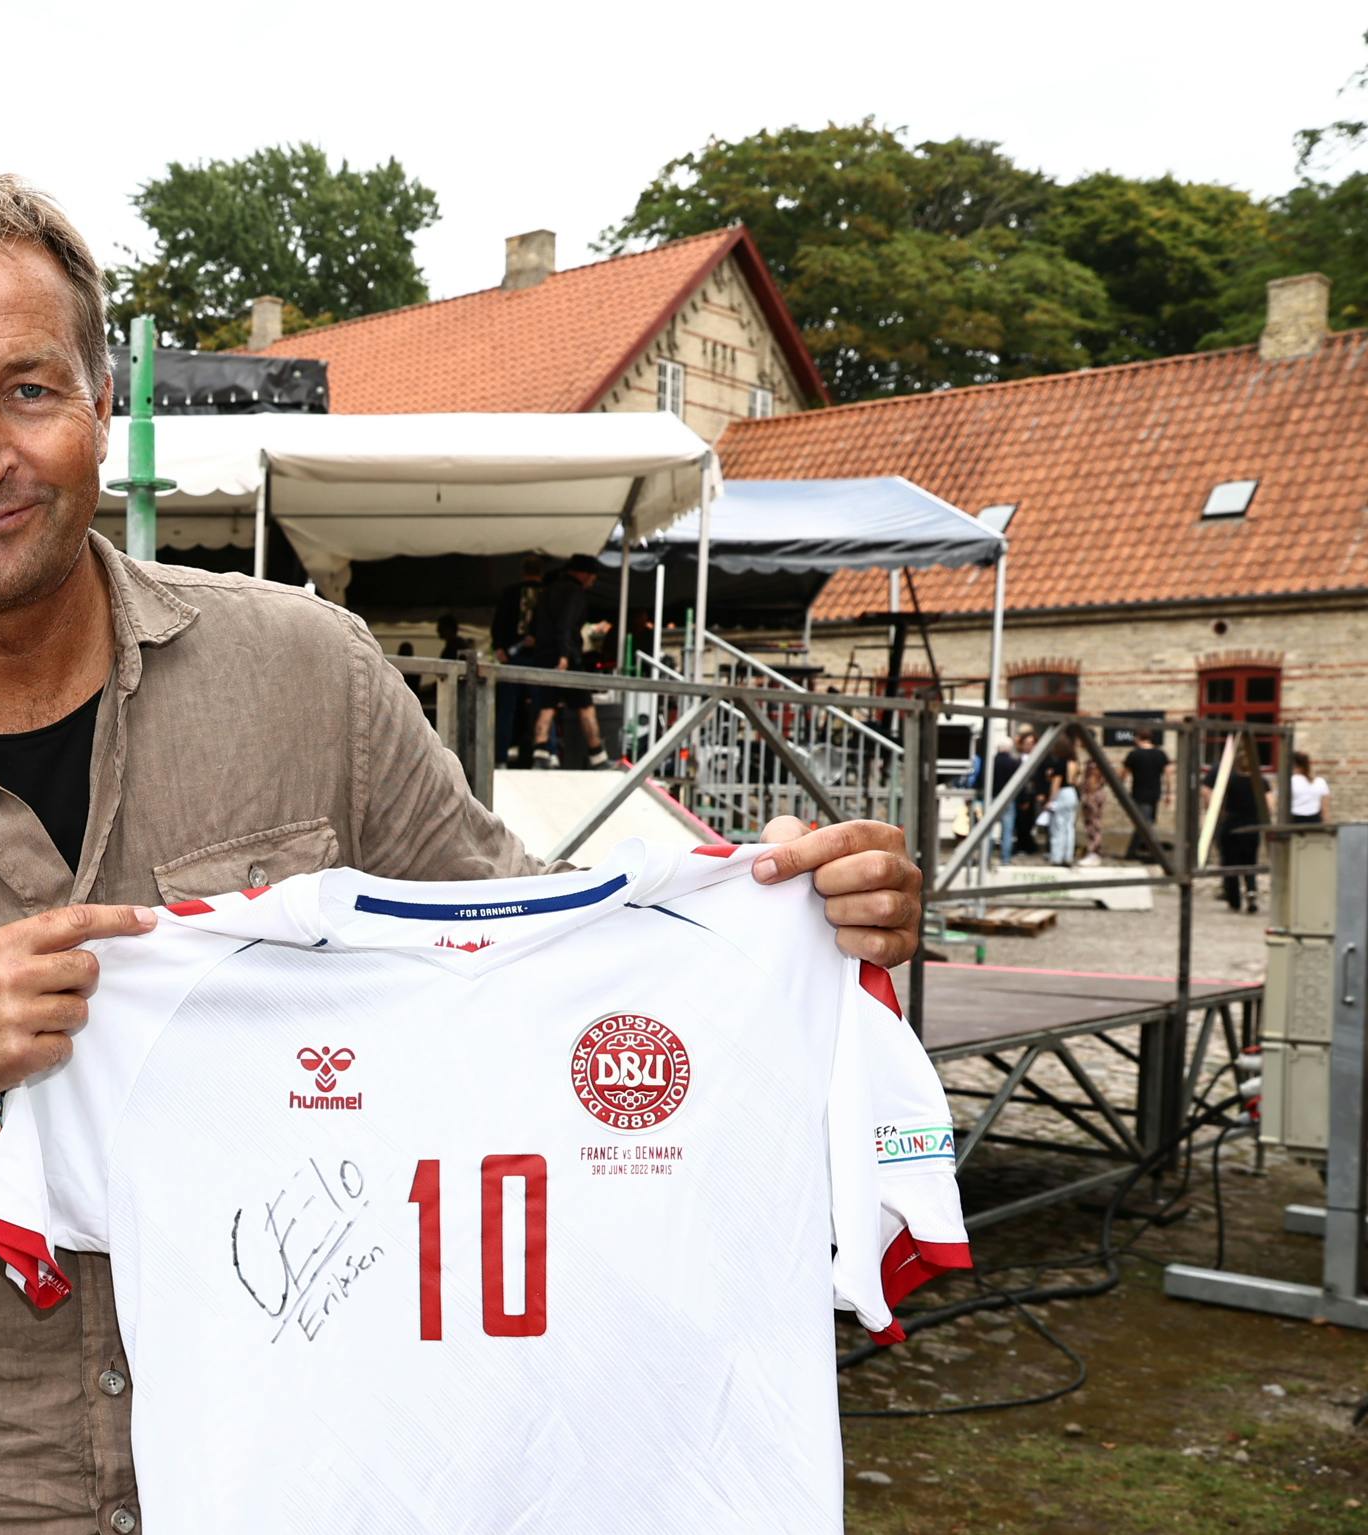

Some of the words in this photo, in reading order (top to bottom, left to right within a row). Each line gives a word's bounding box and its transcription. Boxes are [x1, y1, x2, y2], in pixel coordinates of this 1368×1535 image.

[595, 1051, 667, 1088] DBU
[573, 1045, 603, 1115] DANSK
[289, 1091, 363, 1110] hummel
[607, 1112, 656, 1128] 1889
[580, 1146, 619, 1161] FRANCE
[635, 1146, 683, 1160] DENMARK
[591, 1165, 606, 1175] 3RD
[608, 1165, 628, 1175] JUNE
[630, 1164, 649, 1175] 2022
[651, 1164, 673, 1175] PARIS
[408, 1154, 547, 1341] 10
